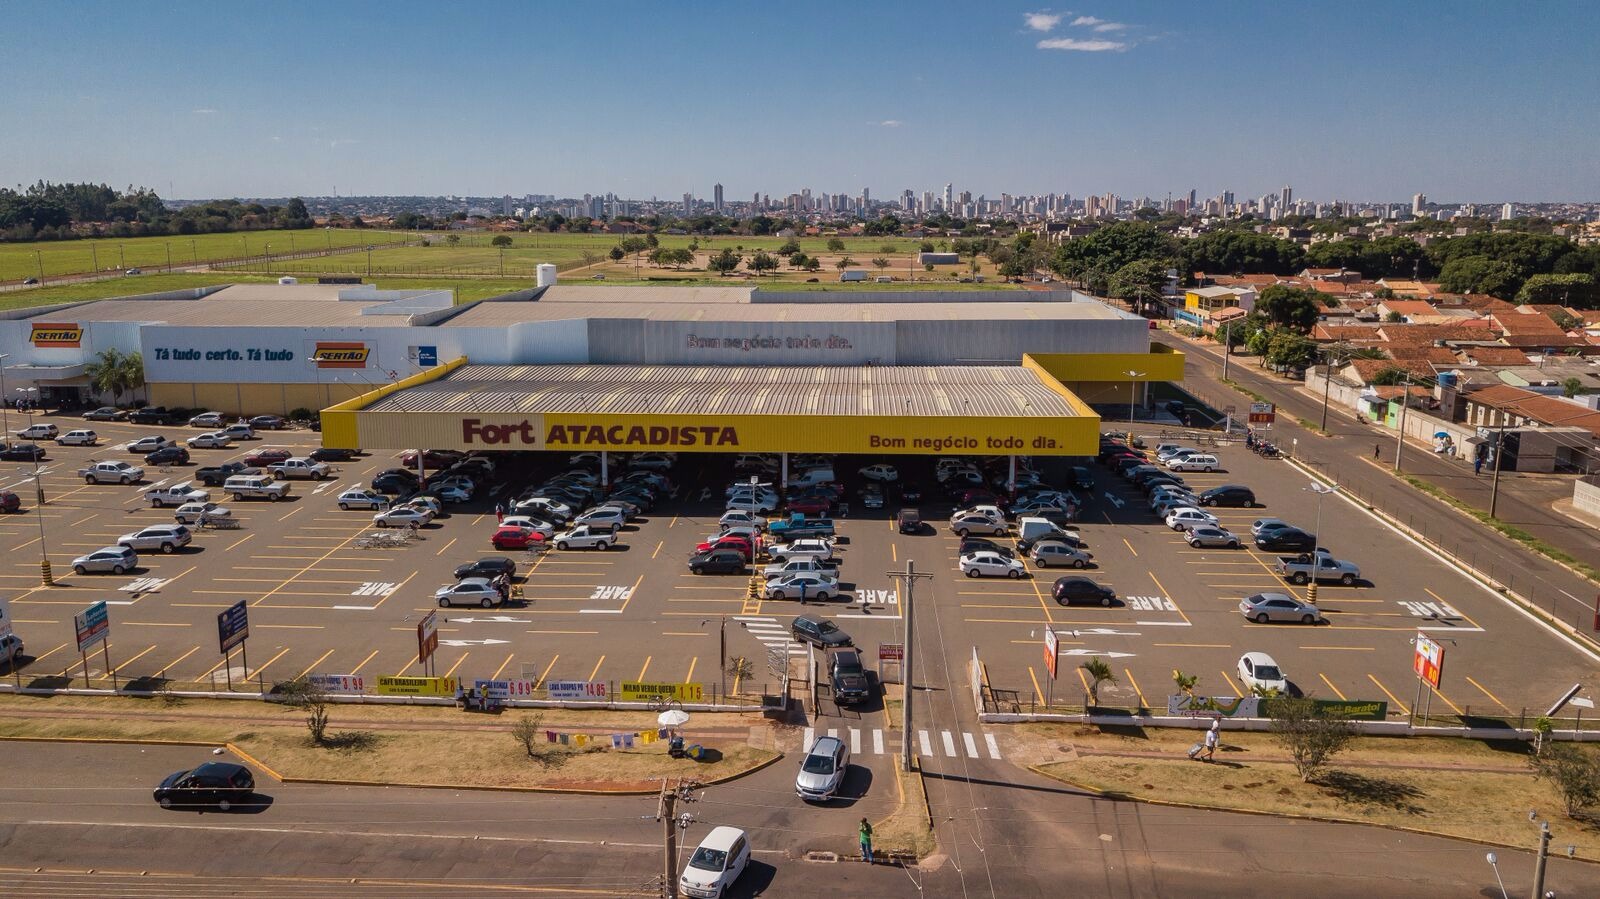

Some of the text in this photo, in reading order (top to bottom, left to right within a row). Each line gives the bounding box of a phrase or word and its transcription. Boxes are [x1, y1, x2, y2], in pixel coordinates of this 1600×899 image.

[35, 331, 77, 340] SERTÃO
[155, 348, 293, 360] Tá tudo certo. Tá tudo
[319, 351, 363, 360] SERTÃO
[462, 418, 535, 444] Fort
[545, 425, 739, 446] ATACADISTA
[870, 435, 1064, 451] Bom negócio todo dia.
[351, 582, 402, 596] PARE
[590, 585, 634, 600] PARE
[855, 589, 898, 604] PARE
[1126, 596, 1177, 611] PARE
[1397, 601, 1463, 616] PARE
